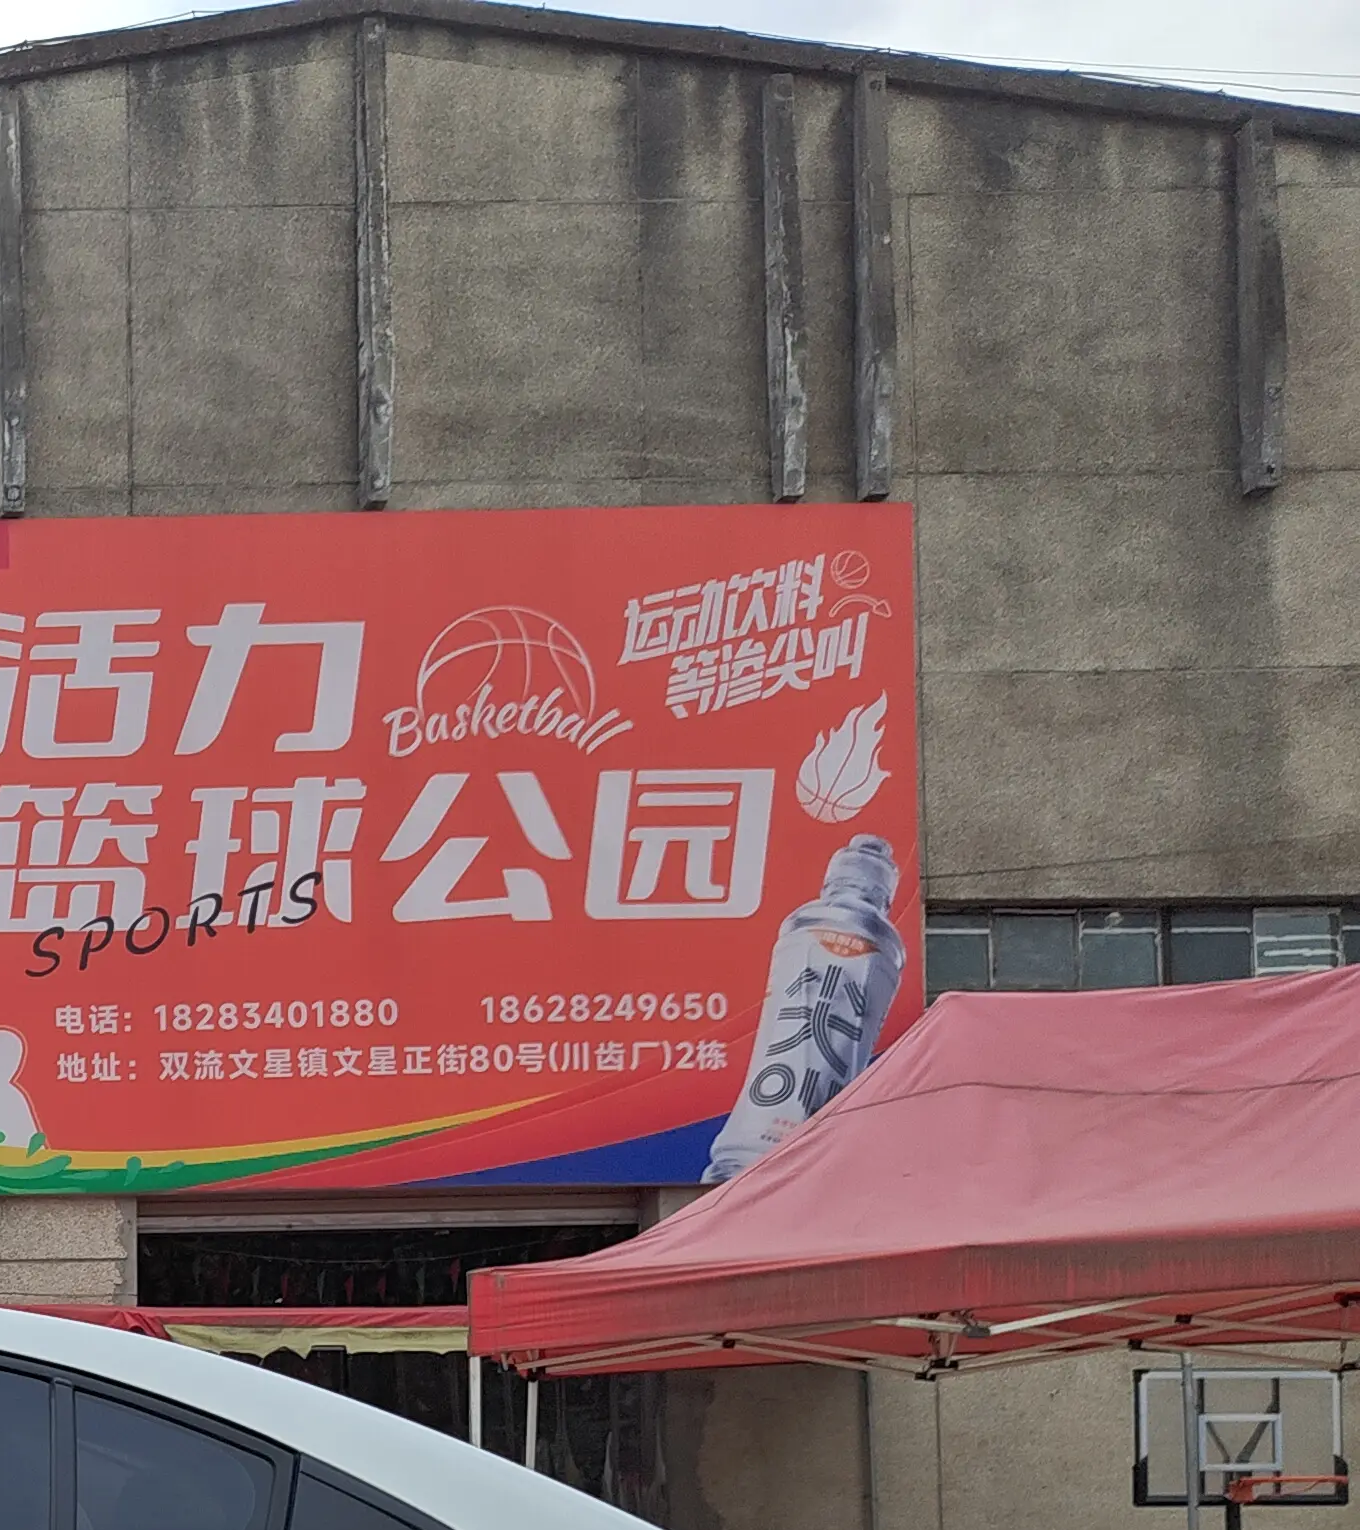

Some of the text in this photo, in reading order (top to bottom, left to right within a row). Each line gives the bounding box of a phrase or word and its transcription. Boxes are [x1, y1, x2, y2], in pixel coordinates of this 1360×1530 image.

[616, 553, 826, 666] 运动饮料
[665, 612, 869, 719] 等渗尖叫
[382, 683, 633, 757] Basketball
[25, 871, 322, 977] SPORTS
[480, 992, 728, 1023] 18628249650
